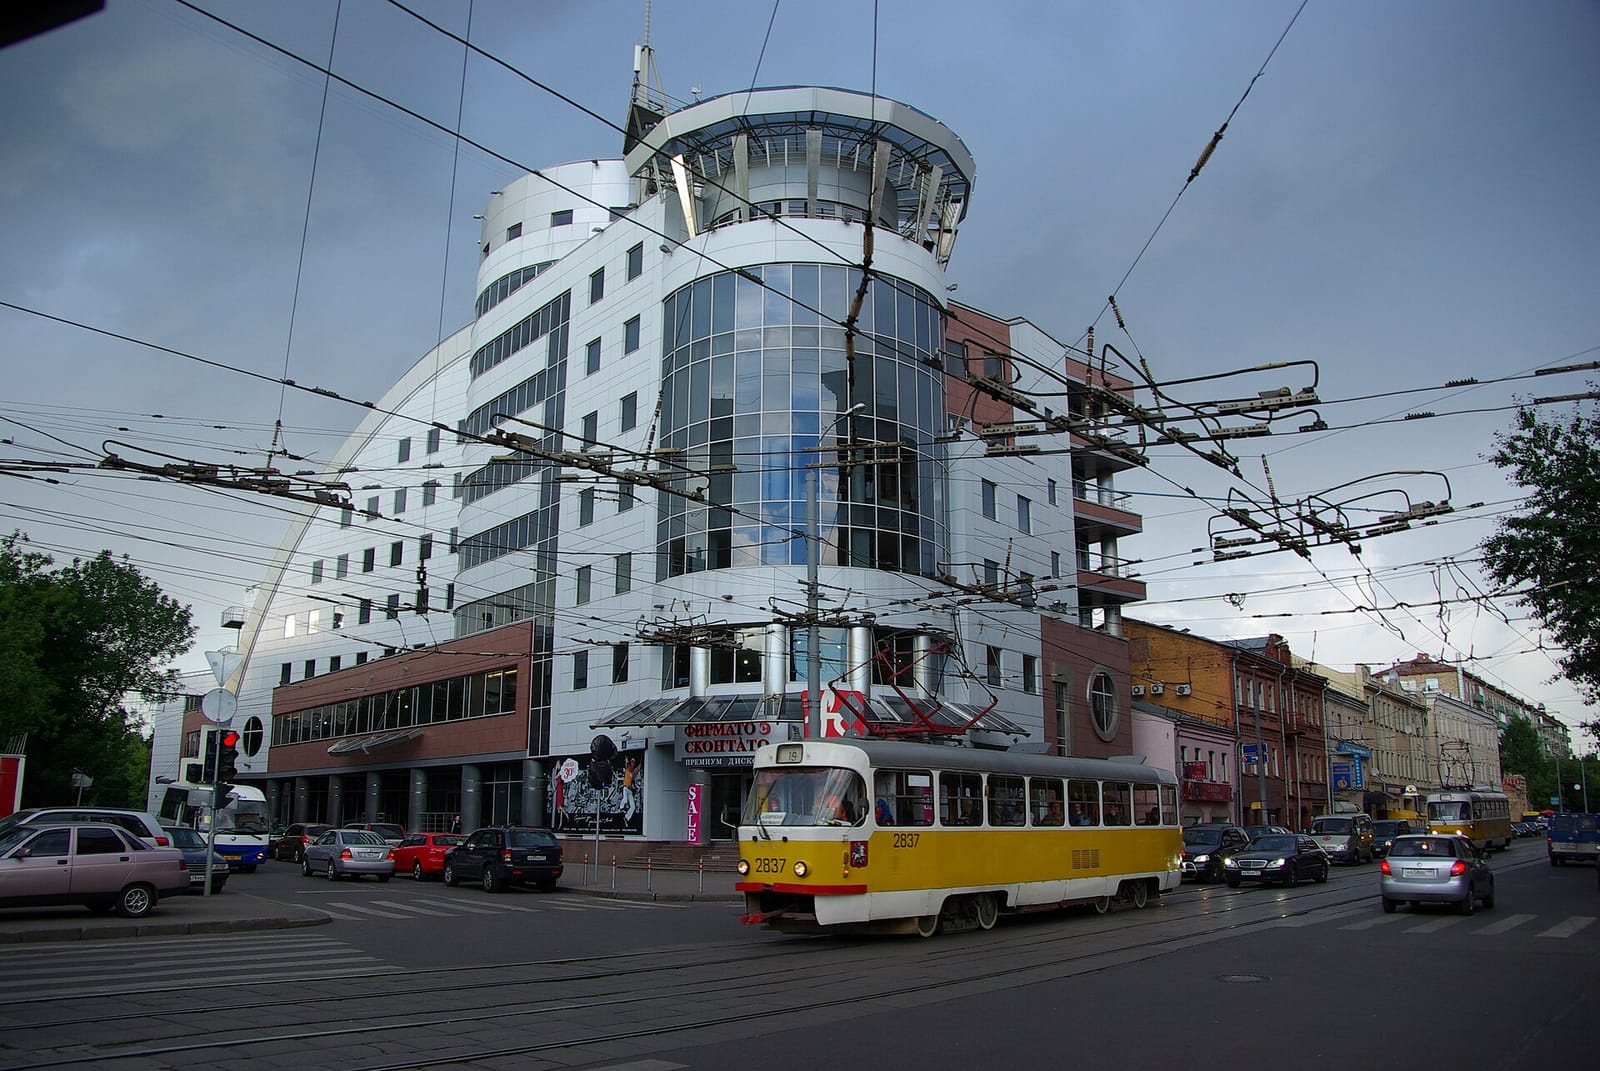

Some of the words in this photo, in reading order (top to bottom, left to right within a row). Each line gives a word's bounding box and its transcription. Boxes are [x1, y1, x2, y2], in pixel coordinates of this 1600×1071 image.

[684, 723, 756, 738] ФИРМАТО
[685, 758, 722, 766] ПРЕМИУМ
[788, 751, 797, 761] 19
[688, 786, 698, 841] SALE
[893, 833, 920, 848] 2837
[755, 858, 786, 873] 2837
